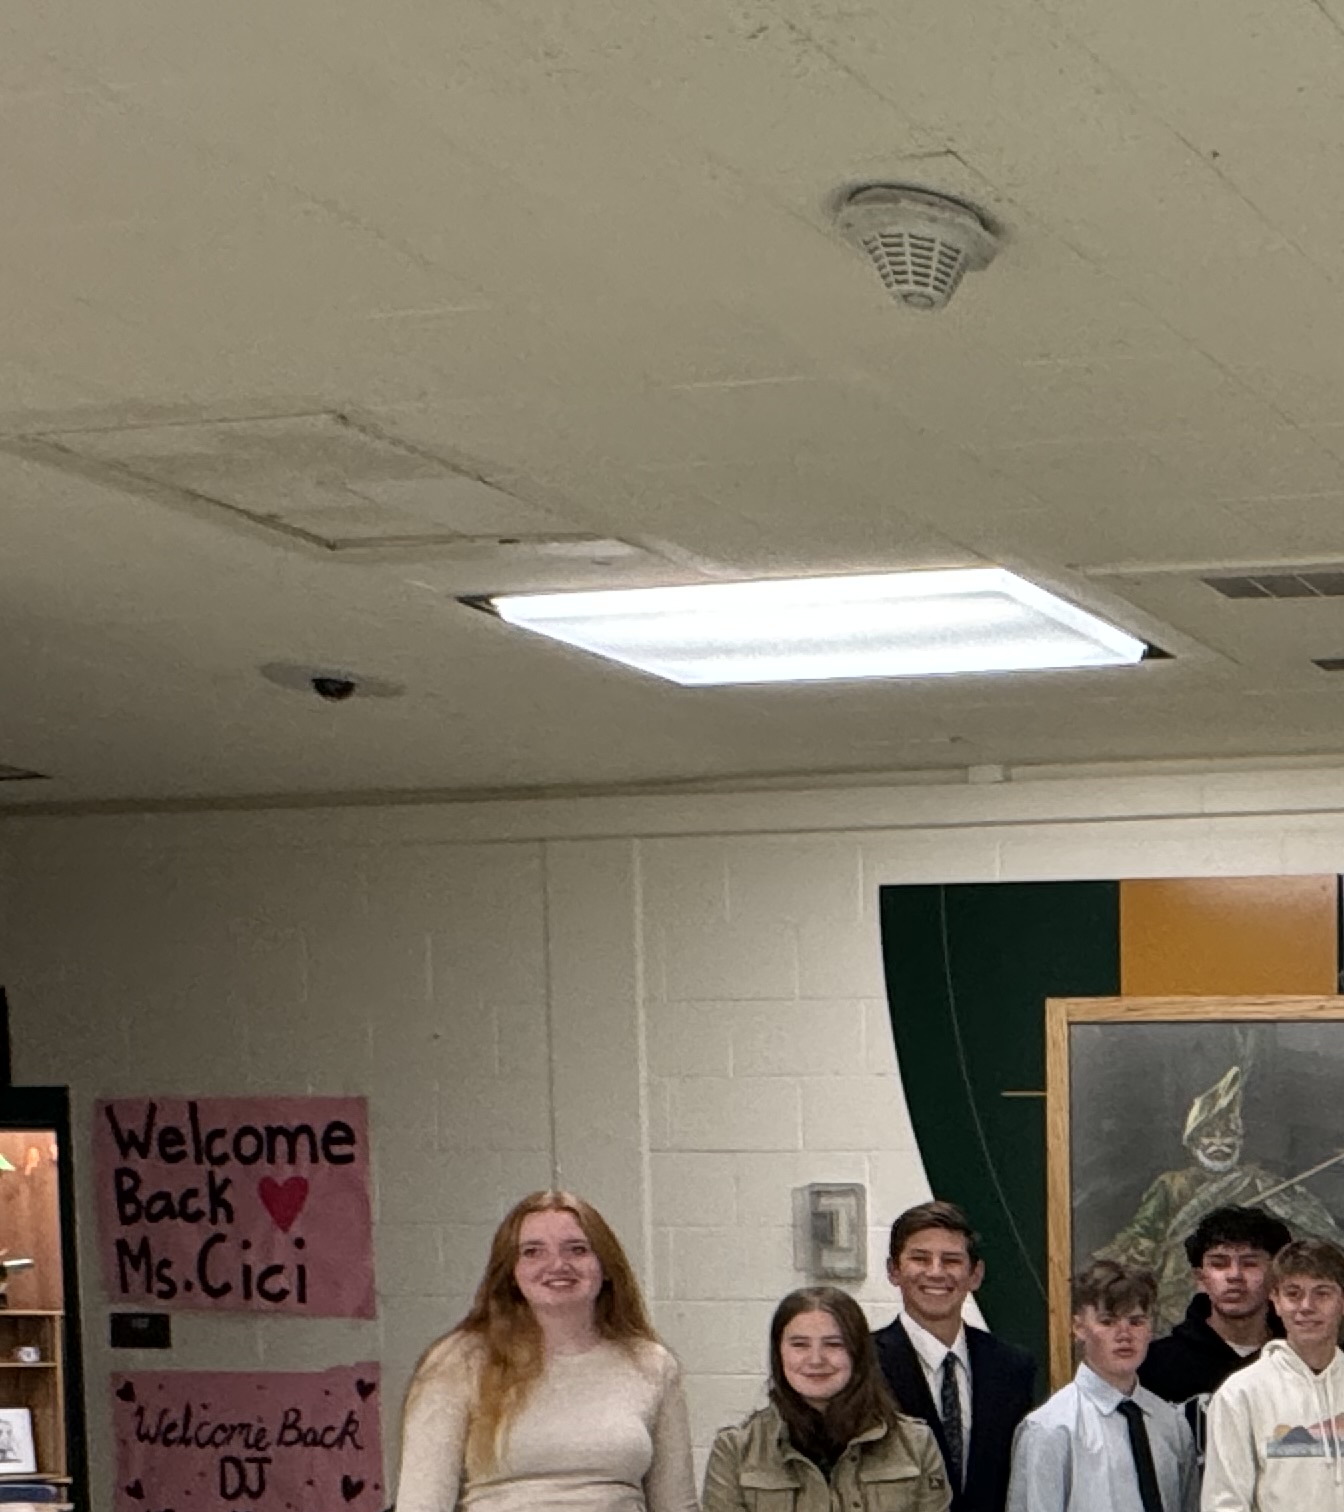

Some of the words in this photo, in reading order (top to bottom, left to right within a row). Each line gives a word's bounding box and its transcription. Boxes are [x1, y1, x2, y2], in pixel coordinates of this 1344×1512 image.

[105, 1101, 356, 1165] Welcome
[114, 1167, 234, 1225] Back
[135, 1402, 271, 1452] Welcome
[277, 1408, 364, 1450] Back
[219, 1456, 272, 1500] DJ
